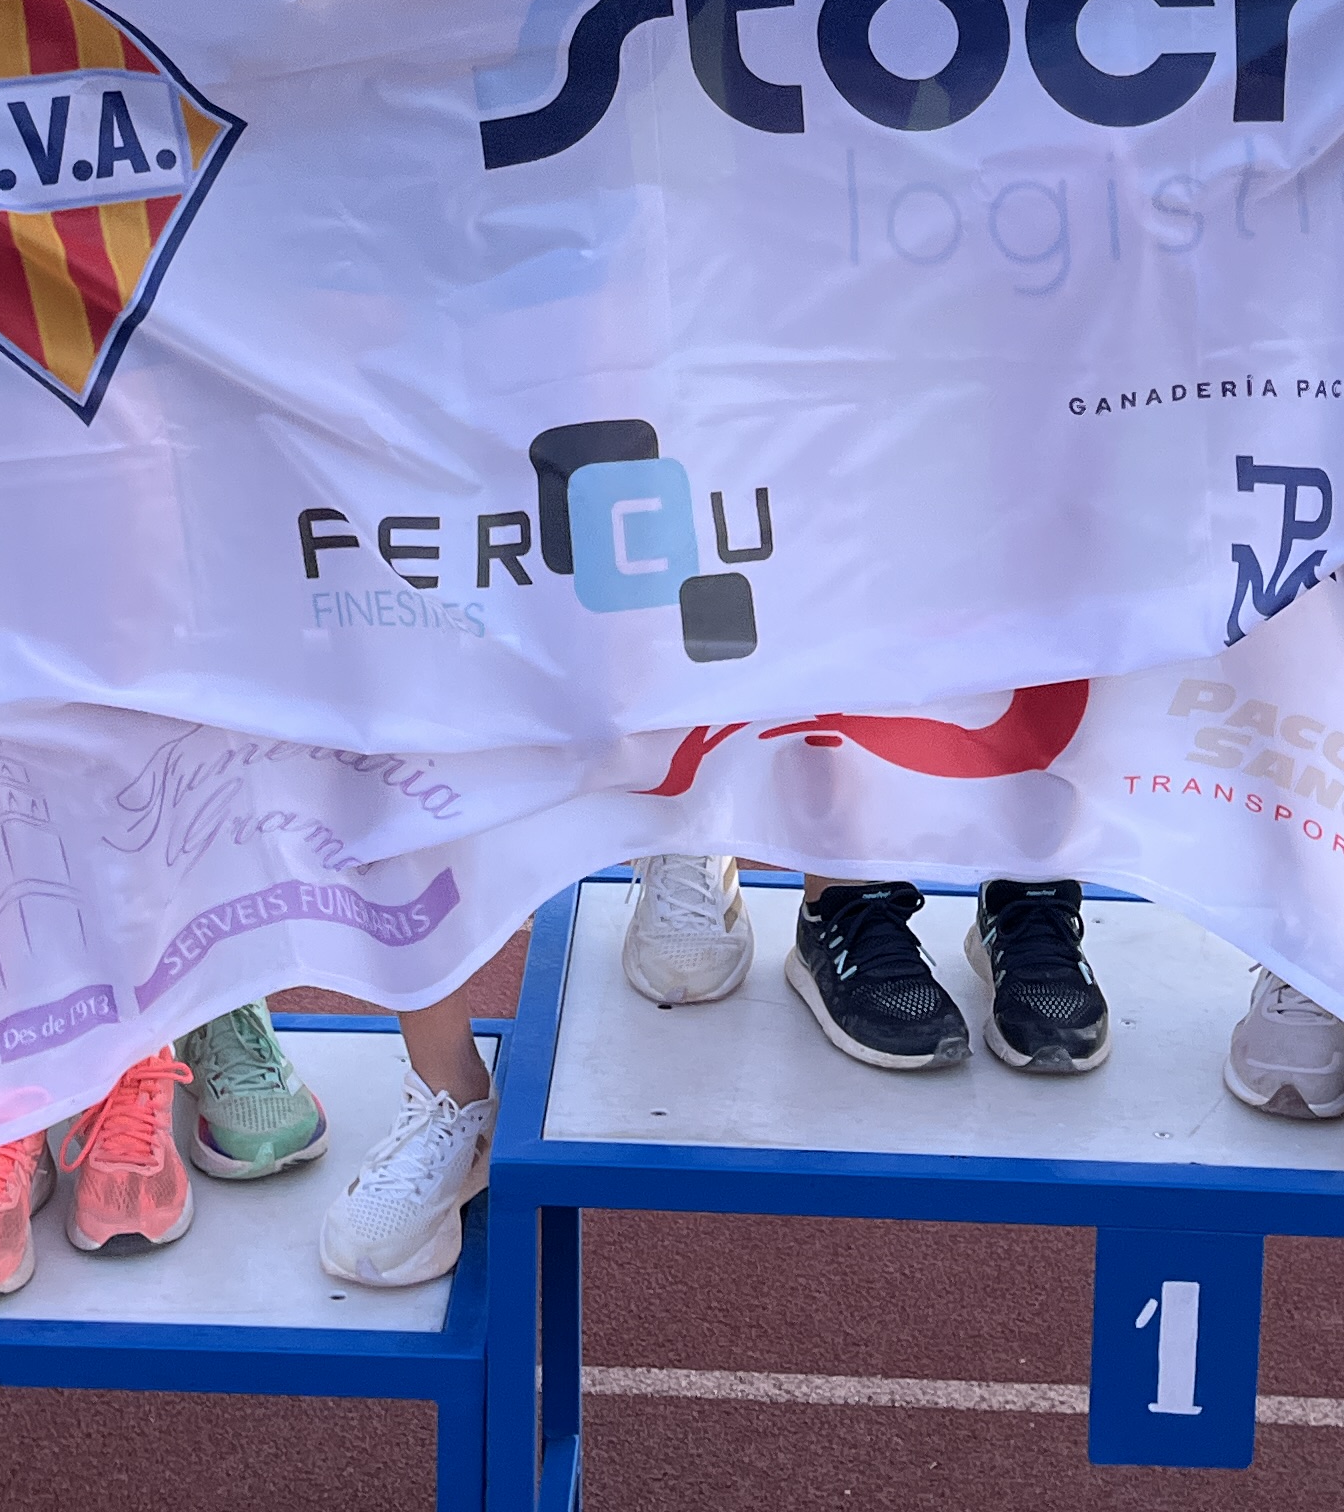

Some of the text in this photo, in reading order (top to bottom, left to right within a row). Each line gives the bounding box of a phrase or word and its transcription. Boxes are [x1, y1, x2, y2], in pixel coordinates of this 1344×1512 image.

[163, 889, 288, 976] SERVEIS
[2, 1027, 37, 1051] Des
[41, 1014, 66, 1038] de
[1134, 1280, 1203, 1415] 1
